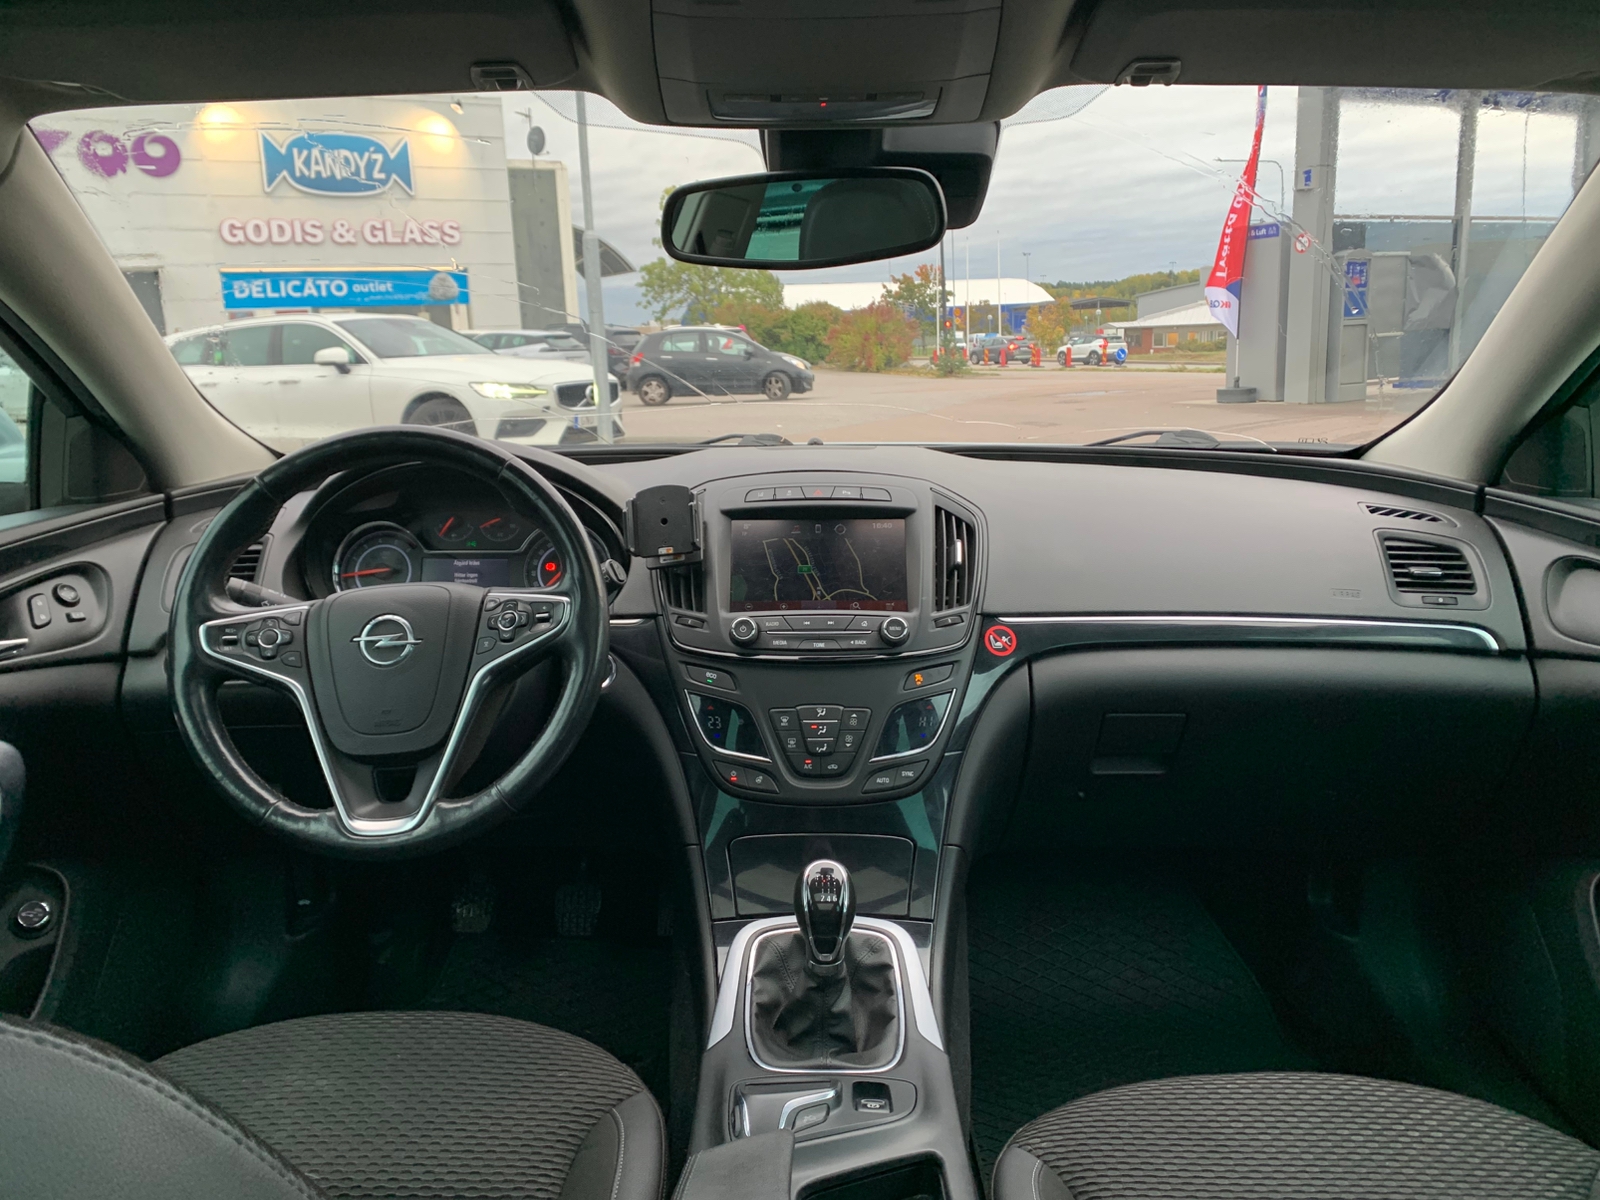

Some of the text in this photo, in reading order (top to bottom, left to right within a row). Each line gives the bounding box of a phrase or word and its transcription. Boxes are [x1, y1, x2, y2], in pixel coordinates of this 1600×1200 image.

[220, 217, 462, 245] GODIS & GLASS
[1256, 227, 1267, 236] Luft
[352, 280, 393, 293] outlet
[707, 716, 722, 729] 23
